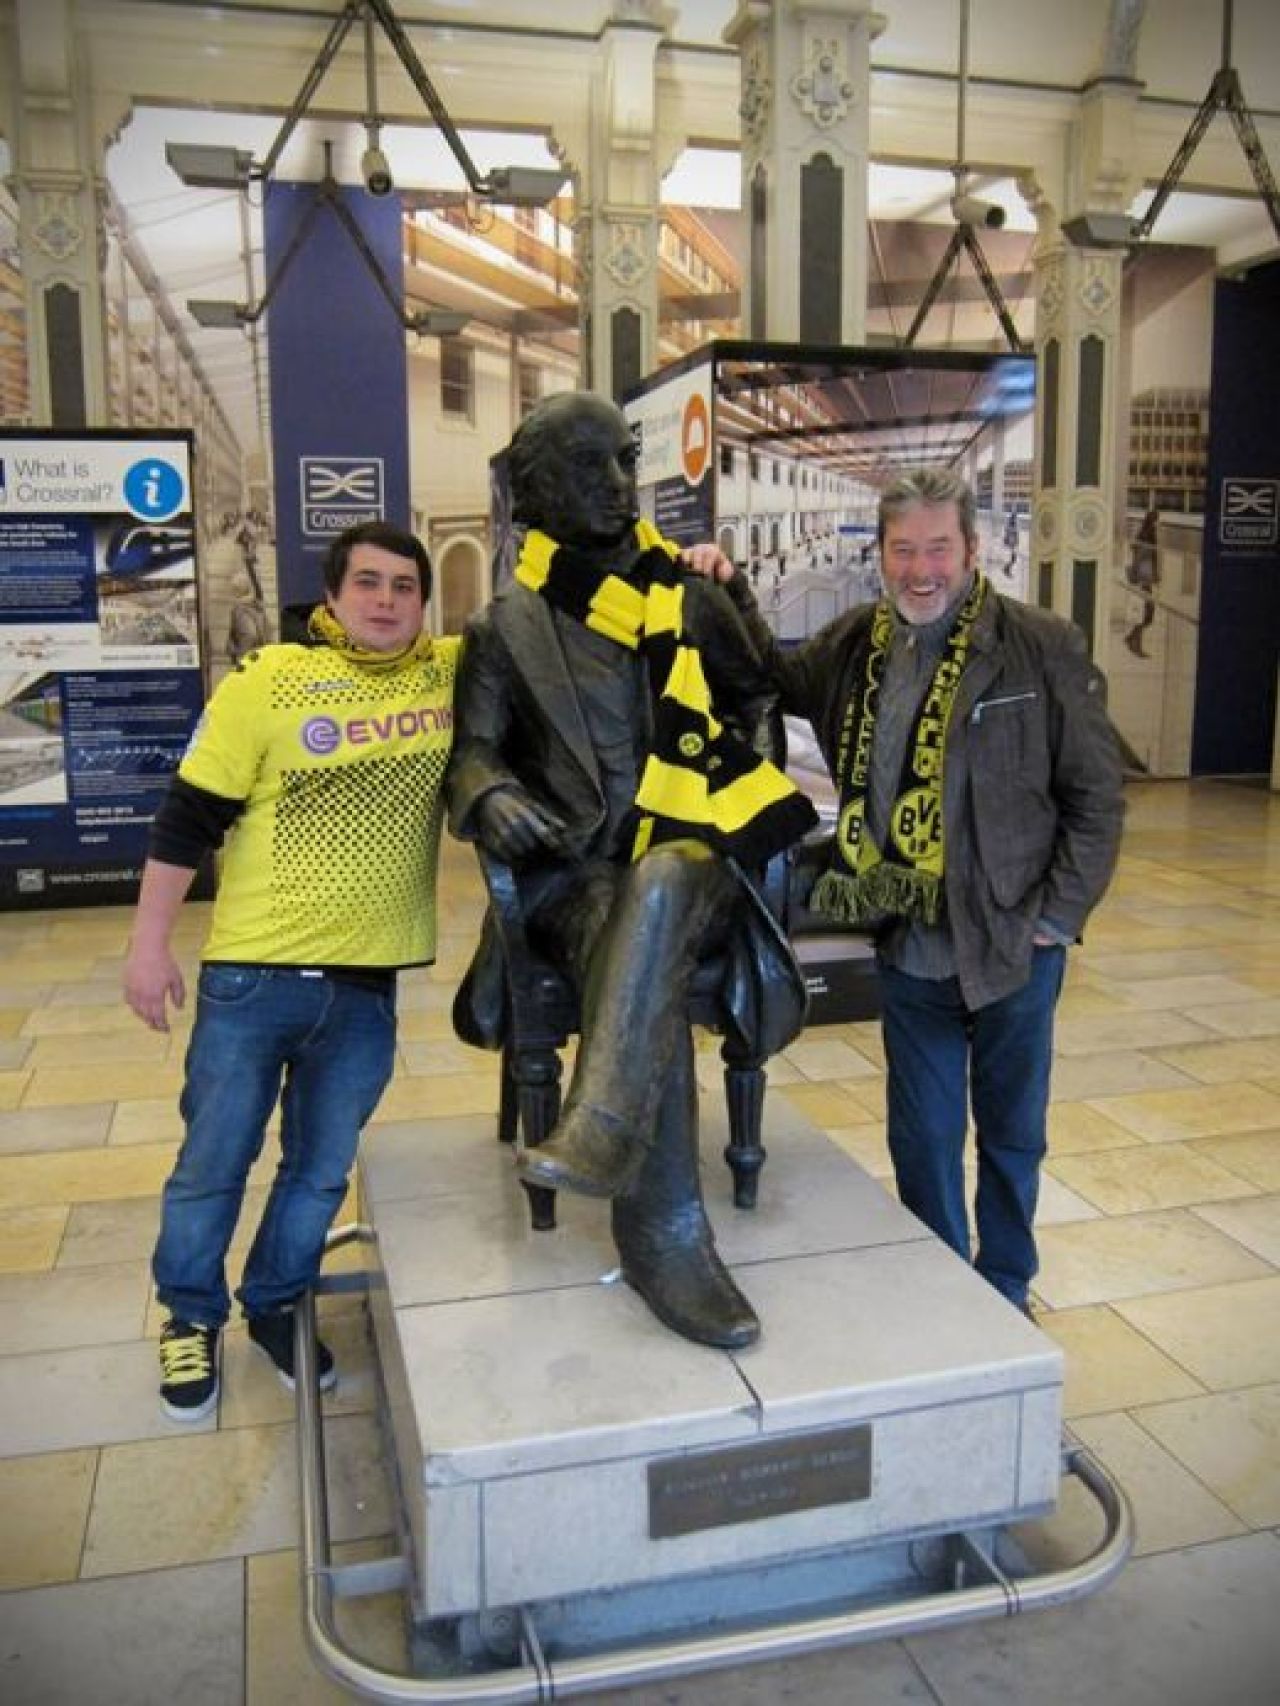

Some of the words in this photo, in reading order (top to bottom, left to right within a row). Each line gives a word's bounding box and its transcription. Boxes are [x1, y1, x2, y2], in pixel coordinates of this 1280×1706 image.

[14, 458, 66, 478] What
[73, 458, 89, 478] is
[16, 482, 113, 502] Crossrail?
[310, 511, 375, 528] Crossr
[346, 708, 453, 744] EVONI
